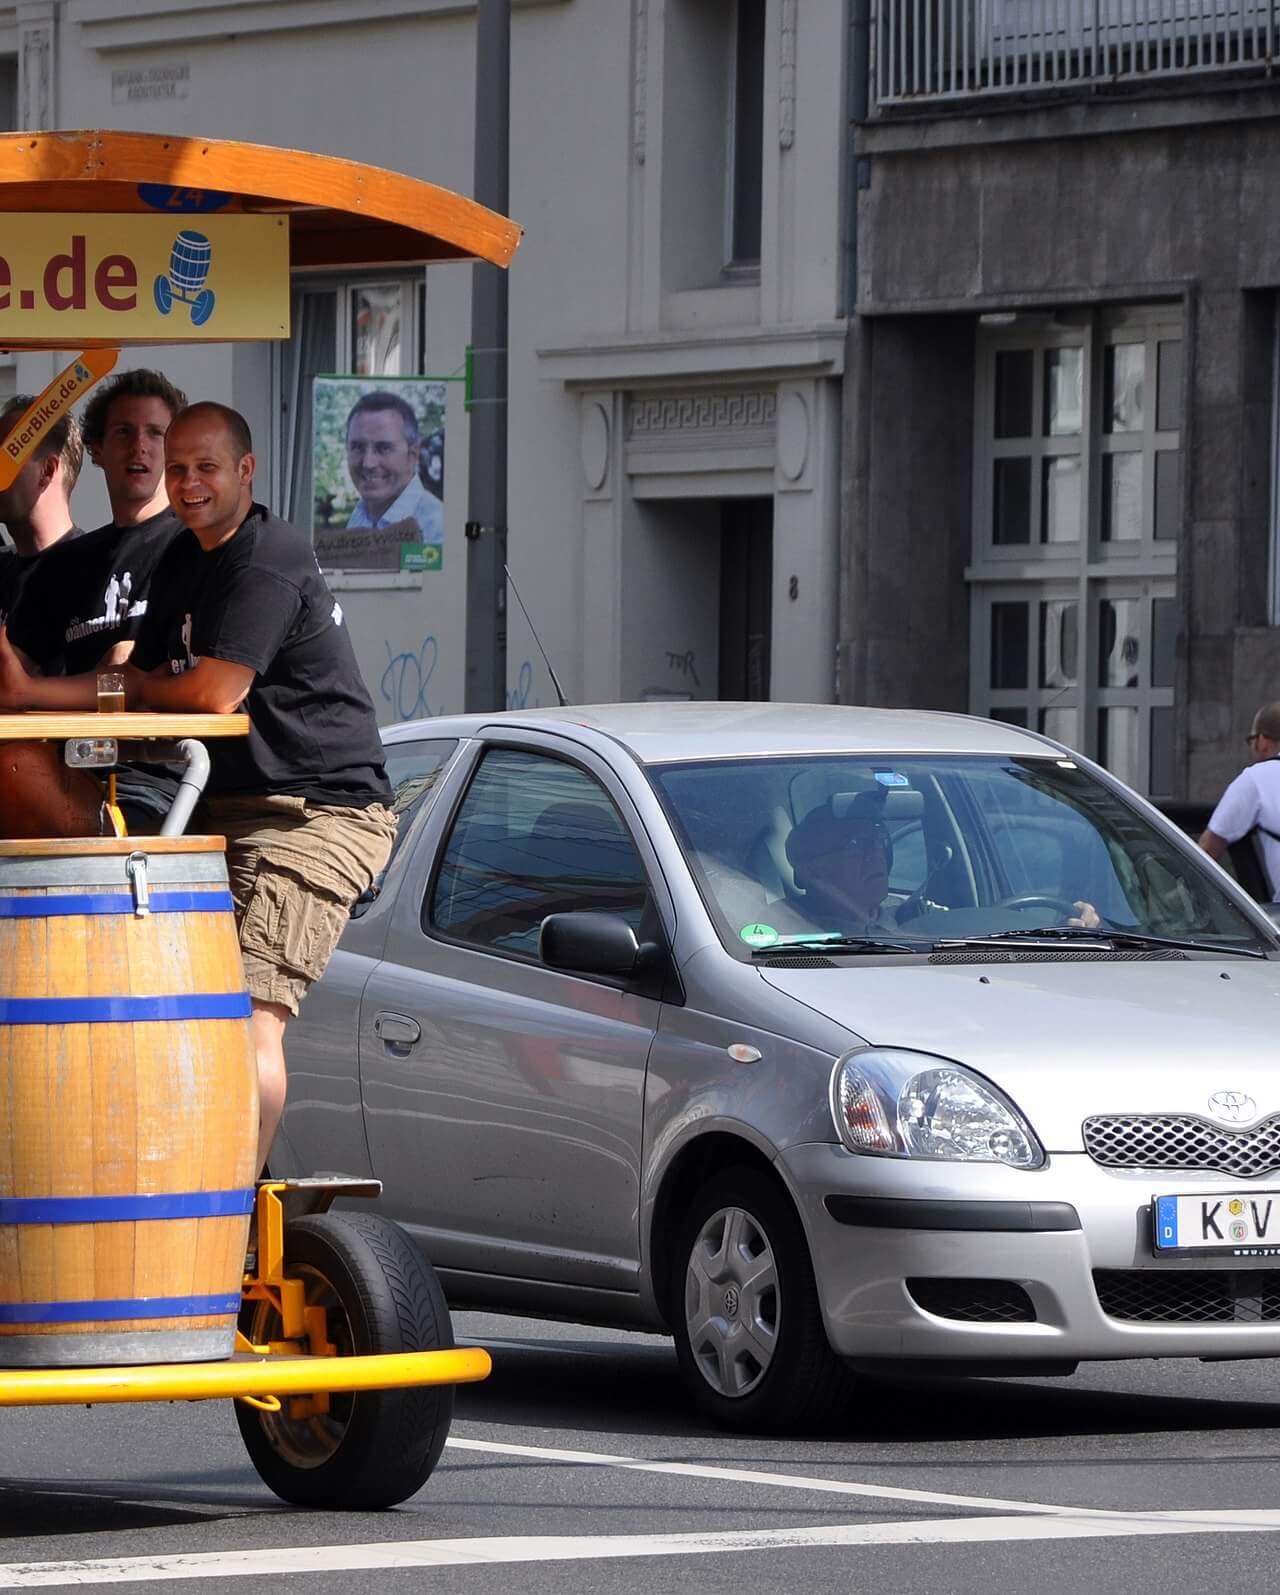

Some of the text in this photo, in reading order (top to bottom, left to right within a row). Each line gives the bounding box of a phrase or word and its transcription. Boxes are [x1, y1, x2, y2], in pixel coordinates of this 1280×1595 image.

[6, 378, 78, 458] BierBike.de
[789, 575, 799, 601] 8
[753, 924, 764, 935] 4
[1164, 1199, 1273, 1240] D K V
